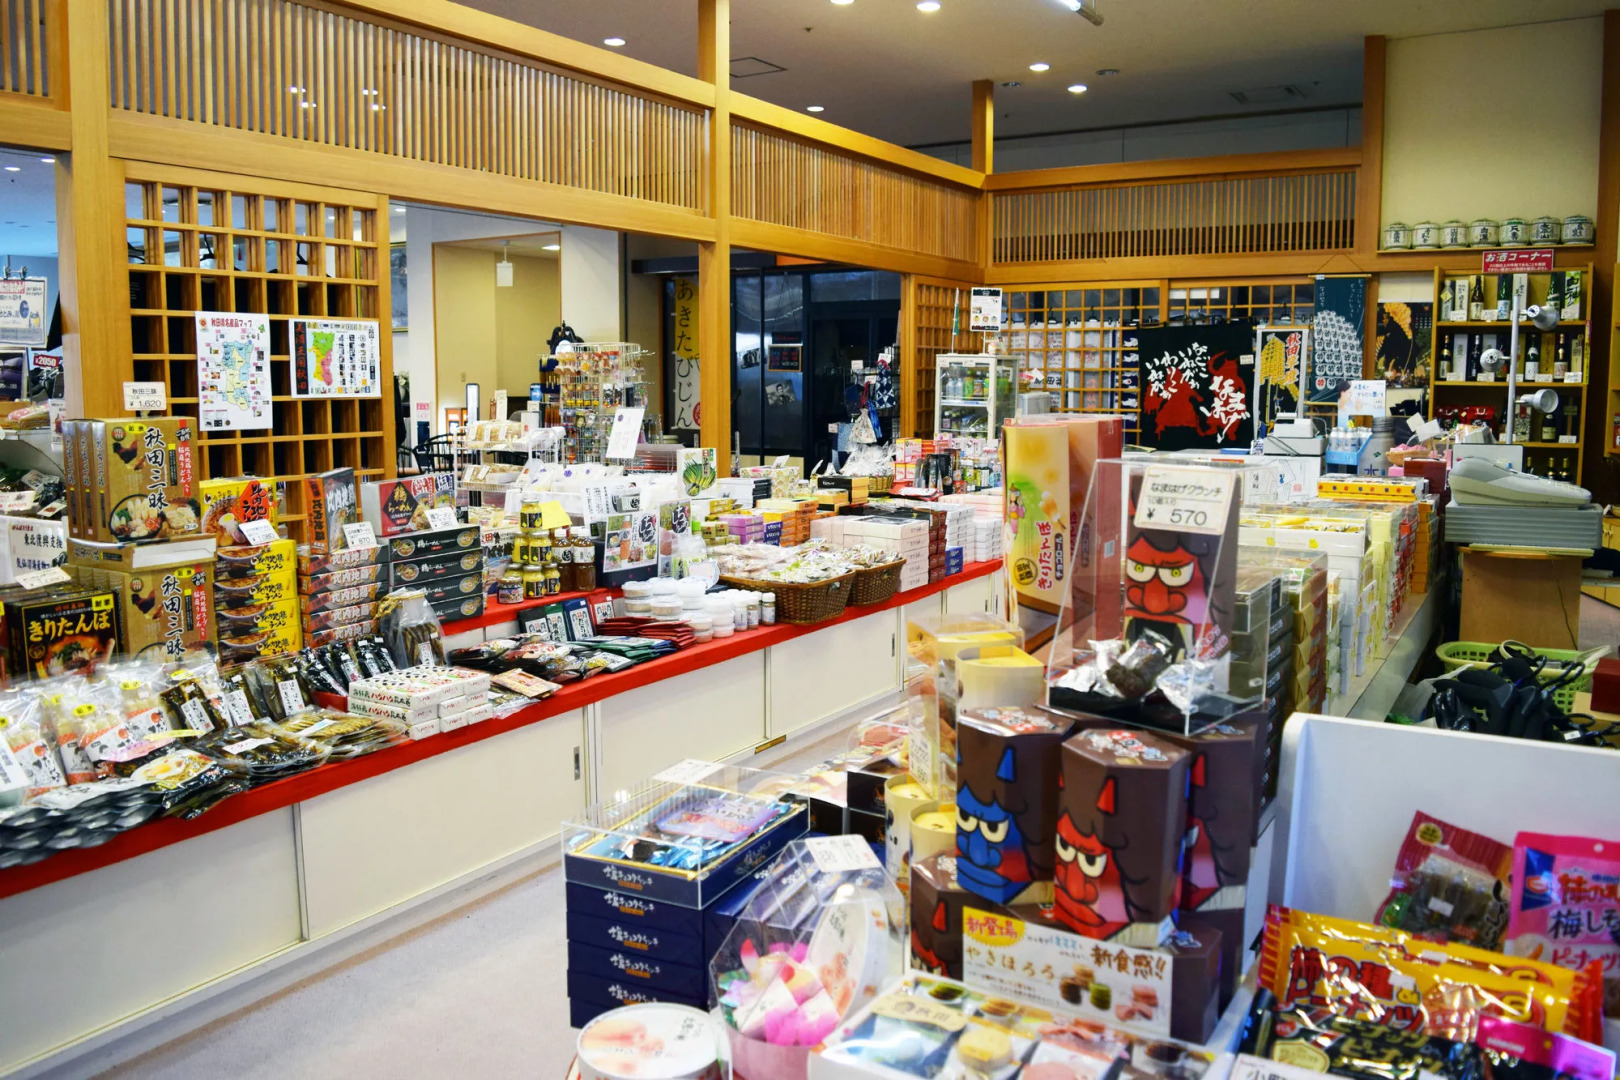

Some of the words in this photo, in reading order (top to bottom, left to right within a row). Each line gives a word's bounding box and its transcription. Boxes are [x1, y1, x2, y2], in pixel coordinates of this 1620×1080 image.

[1485, 252, 1552, 262] お酒コーナー
[676, 280, 693, 428] あきたびじん
[145, 427, 169, 510] 秋田三昧
[1150, 482, 1223, 497] なまはげクランチ
[1170, 508, 1208, 526] 570
[1036, 521, 1053, 590] きりたんぽ
[1055, 535, 1063, 579] チョコロール
[28, 607, 112, 643] きりたんぽ
[161, 575, 186, 656] 秋田三昧
[966, 915, 1018, 939] 新登場
[966, 945, 1055, 980] やきほろろ
